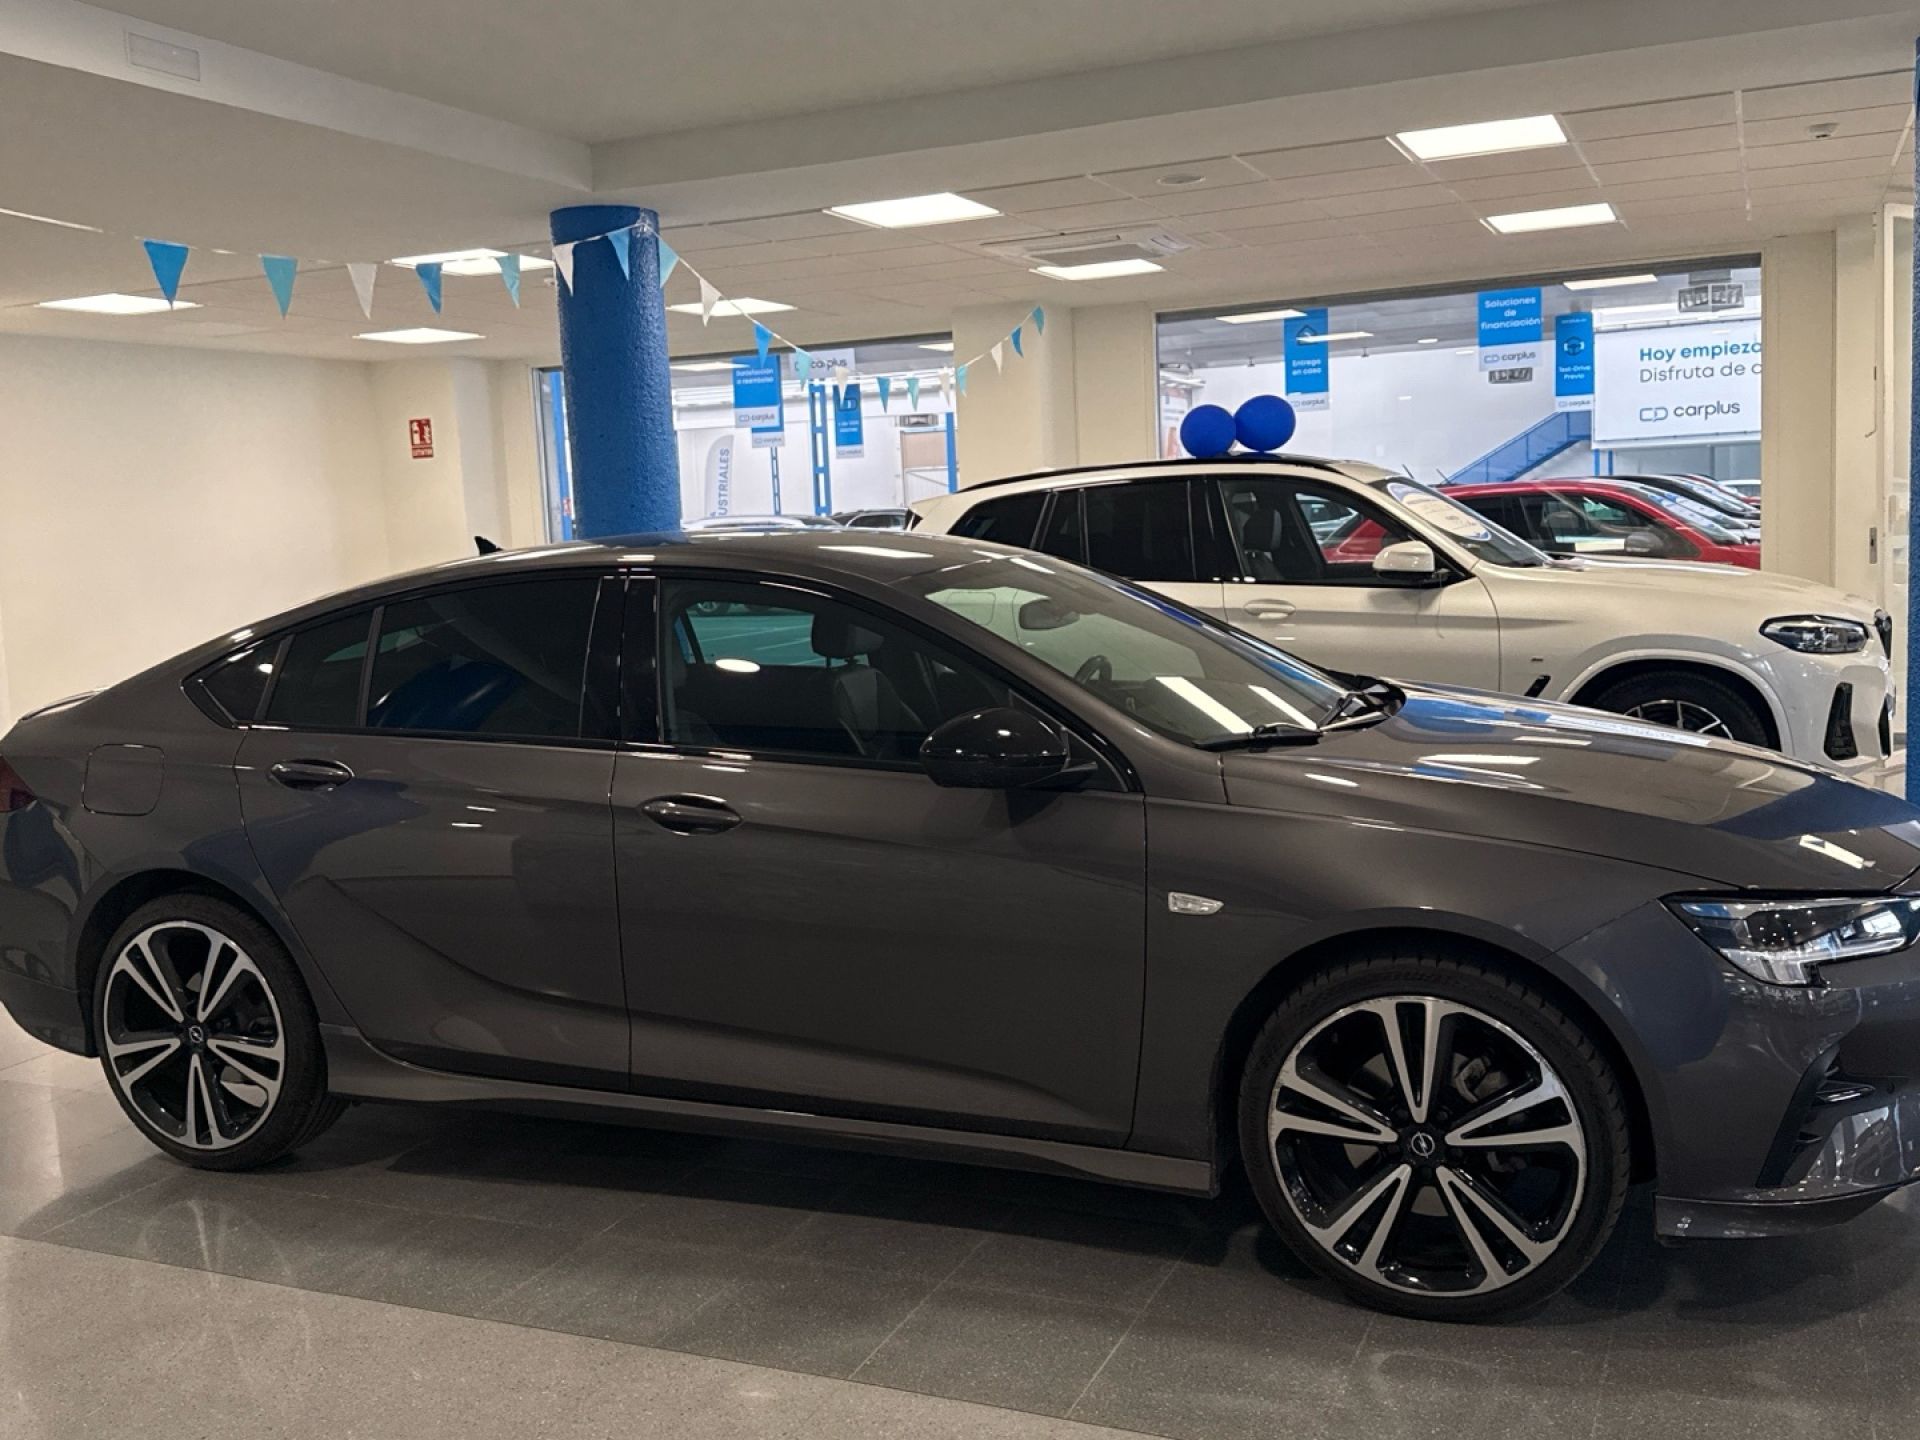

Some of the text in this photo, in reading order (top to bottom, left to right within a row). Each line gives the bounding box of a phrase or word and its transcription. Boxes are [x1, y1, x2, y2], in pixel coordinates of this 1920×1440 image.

[1484, 297, 1536, 309] Soluciones
[1504, 309, 1517, 317] de
[1501, 352, 1536, 362] carplus
[1639, 347, 1676, 363] Hoy
[1639, 366, 1714, 383] Disfruta
[1719, 362, 1746, 377] de
[1672, 401, 1741, 421] carplus
[718, 448, 730, 516] USTRIALES
